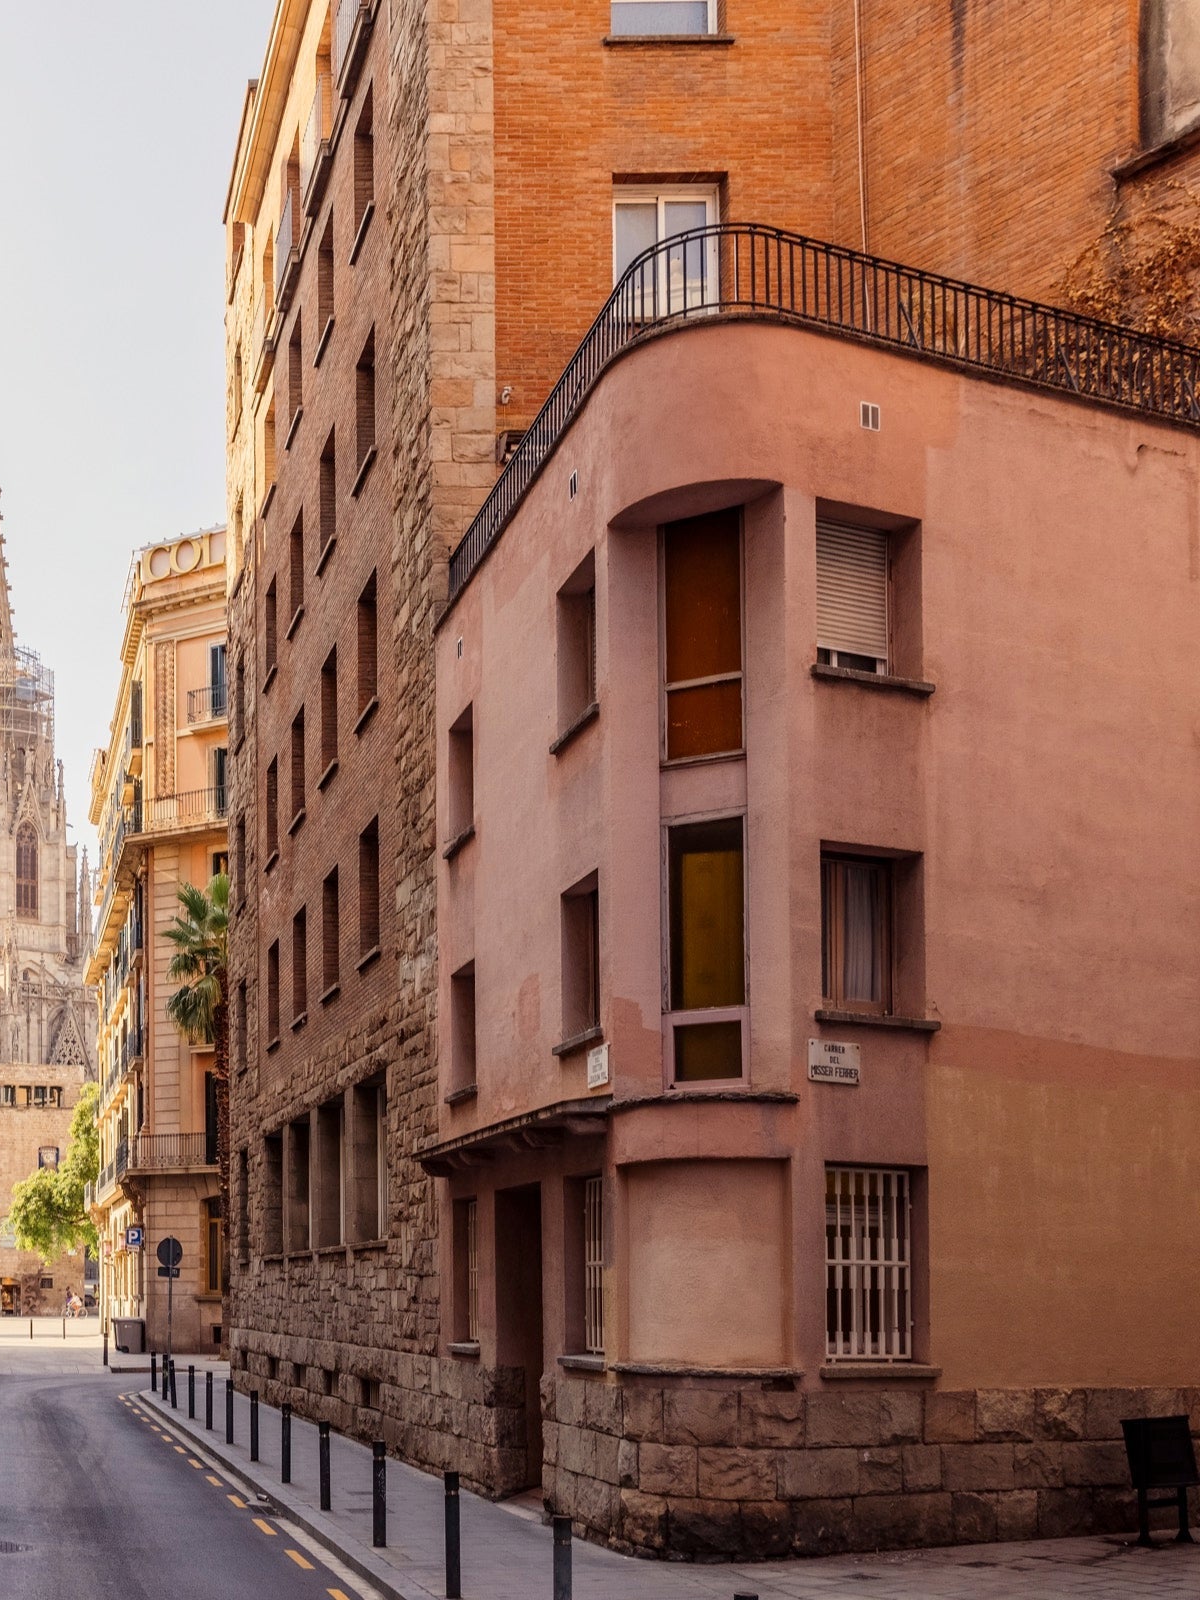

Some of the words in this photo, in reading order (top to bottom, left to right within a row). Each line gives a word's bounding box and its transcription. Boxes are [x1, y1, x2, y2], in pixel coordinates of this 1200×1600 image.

[824, 1044, 845, 1054] CARRER
[829, 1056, 840, 1064] DEL
[811, 1065, 834, 1077] MISSER
[834, 1067, 859, 1079] FERRER
[128, 1230, 138, 1244] P
